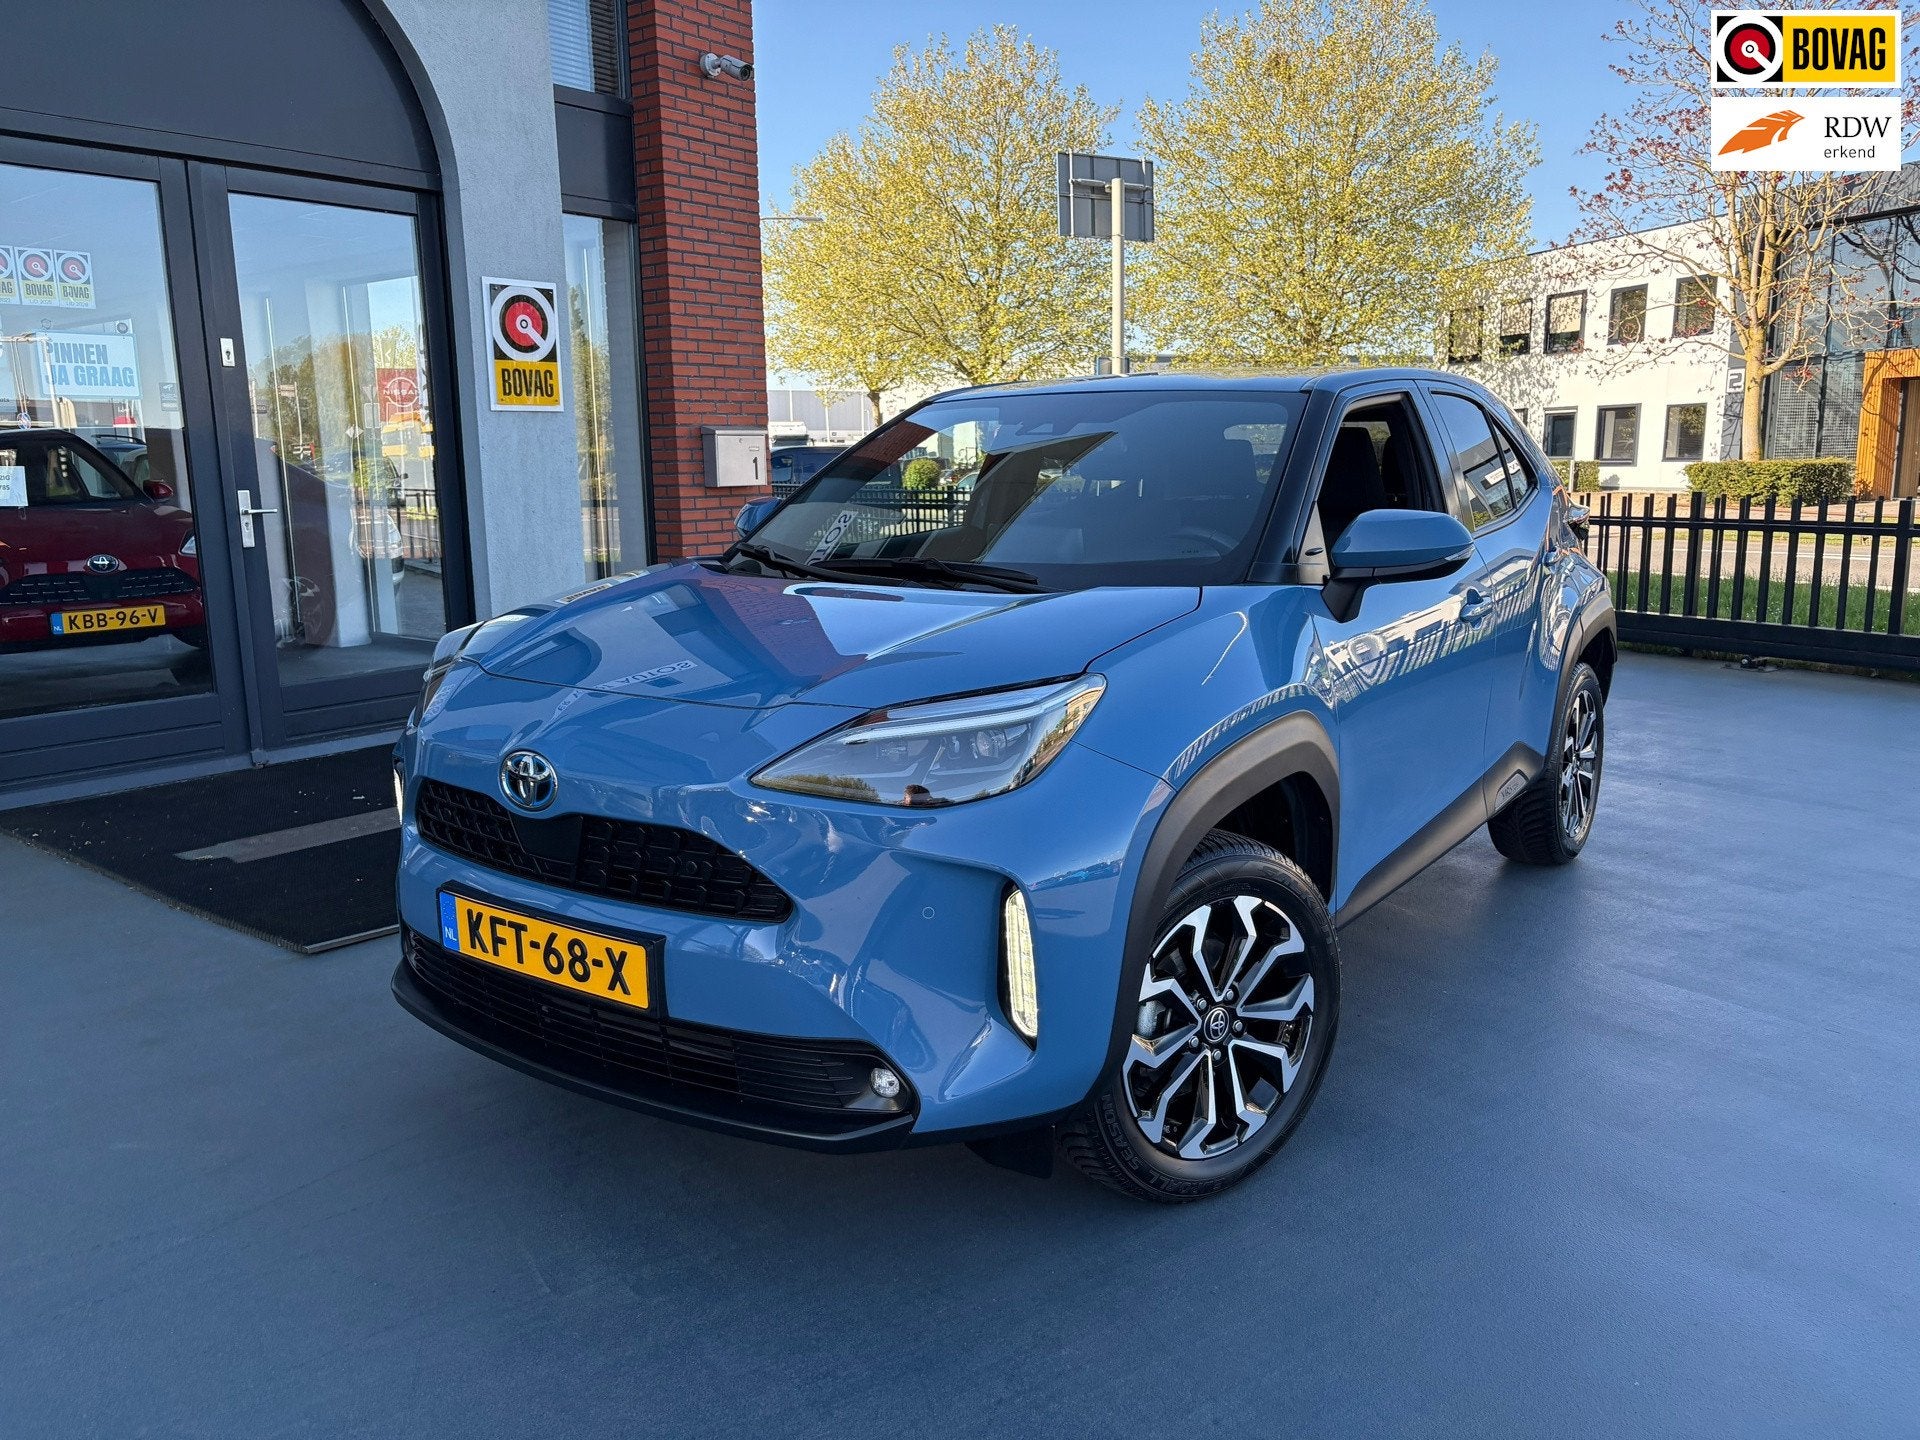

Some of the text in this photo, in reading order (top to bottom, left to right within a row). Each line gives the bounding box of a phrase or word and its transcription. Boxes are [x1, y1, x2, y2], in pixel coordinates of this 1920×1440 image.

[25, 283, 53, 297] BOVAG
[62, 285, 90, 299] BOVAG
[43, 342, 108, 364] PINNEN
[74, 365, 135, 387] GRAAG
[502, 368, 554, 398] BOVAG
[1729, 372, 1743, 389] 2
[752, 456, 760, 480] 1
[68, 606, 158, 631] KBB-96-V
[444, 908, 632, 996] NL KFT-68-X
